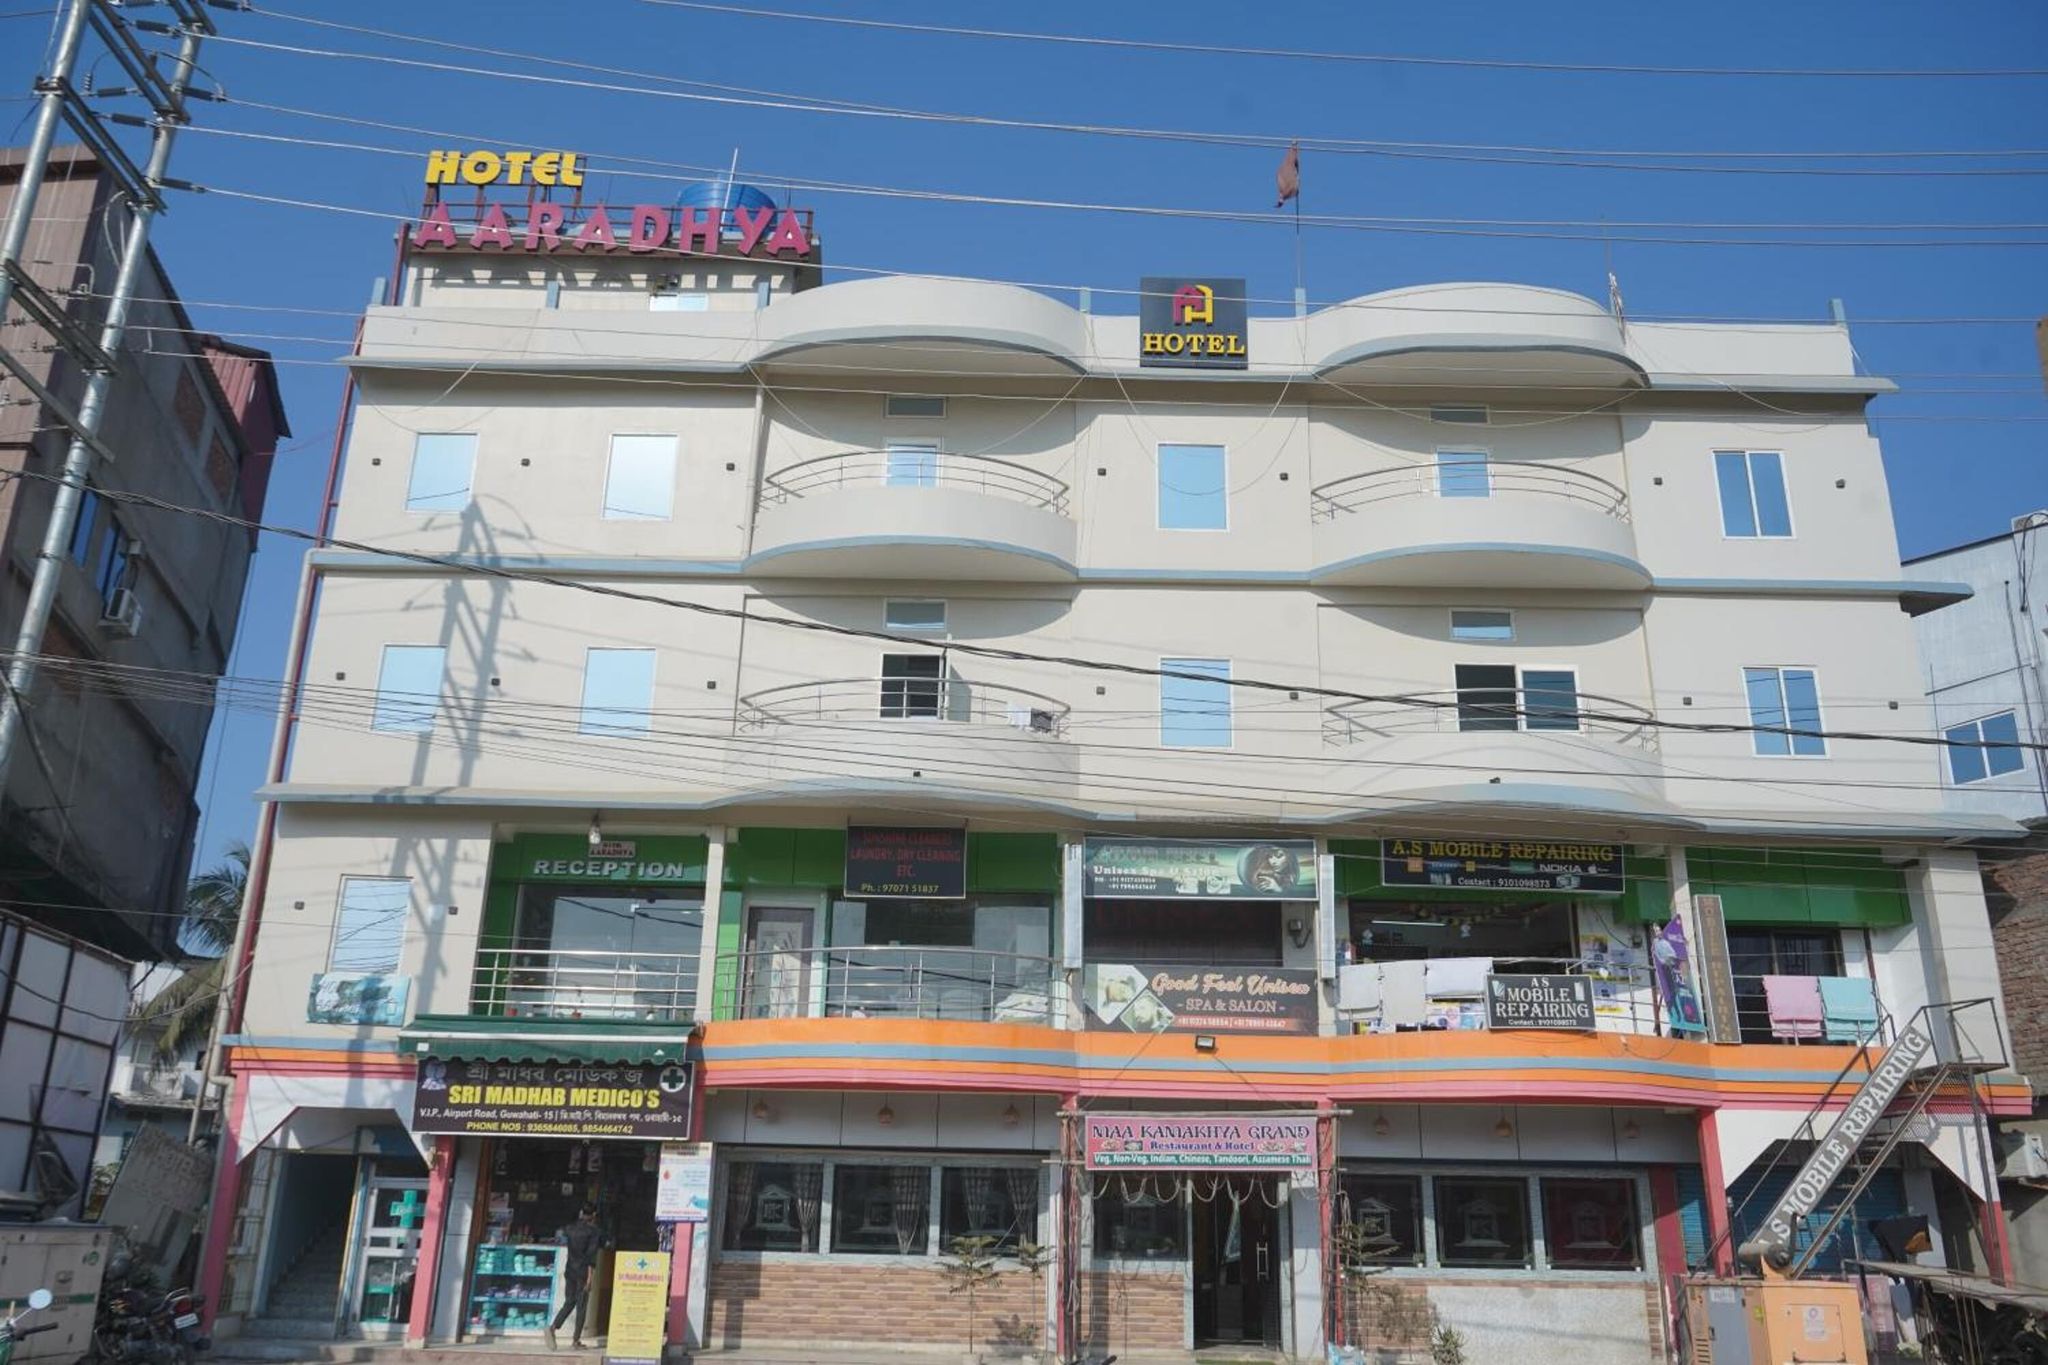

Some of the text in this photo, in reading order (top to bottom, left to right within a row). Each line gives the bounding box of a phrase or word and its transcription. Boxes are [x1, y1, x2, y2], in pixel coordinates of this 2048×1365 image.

[425, 150, 584, 187] HOTEL
[413, 201, 811, 255] AARADHYA
[1143, 332, 1246, 355] HOTEL
[1429, 841, 1502, 858] MOBILE
[1509, 844, 1614, 861] REPAIRING
[534, 860, 685, 878] RECEPTION
[1540, 863, 1582, 873] NOKIA
[1152, 973, 1199, 996] Good
[1507, 988, 1571, 1002] MOBILE
[1185, 999, 1277, 1012] SPA & SALON
[1496, 1002, 1590, 1018] REPAIRING
[449, 1085, 661, 1109] SRI MADHAB MEDICO'S
[443, 1109, 473, 1121] Airport
[467, 1121, 499, 1131] PHONE
[1093, 1126, 1310, 1139] MAA KAMAKHYA GRAND
[1783, 1139, 1849, 1219] MOBILE
[1841, 1032, 1925, 1140] REPAIRING
[1150, 1141, 1213, 1150] Restaurant
[1225, 1141, 1255, 1150] Hotel
